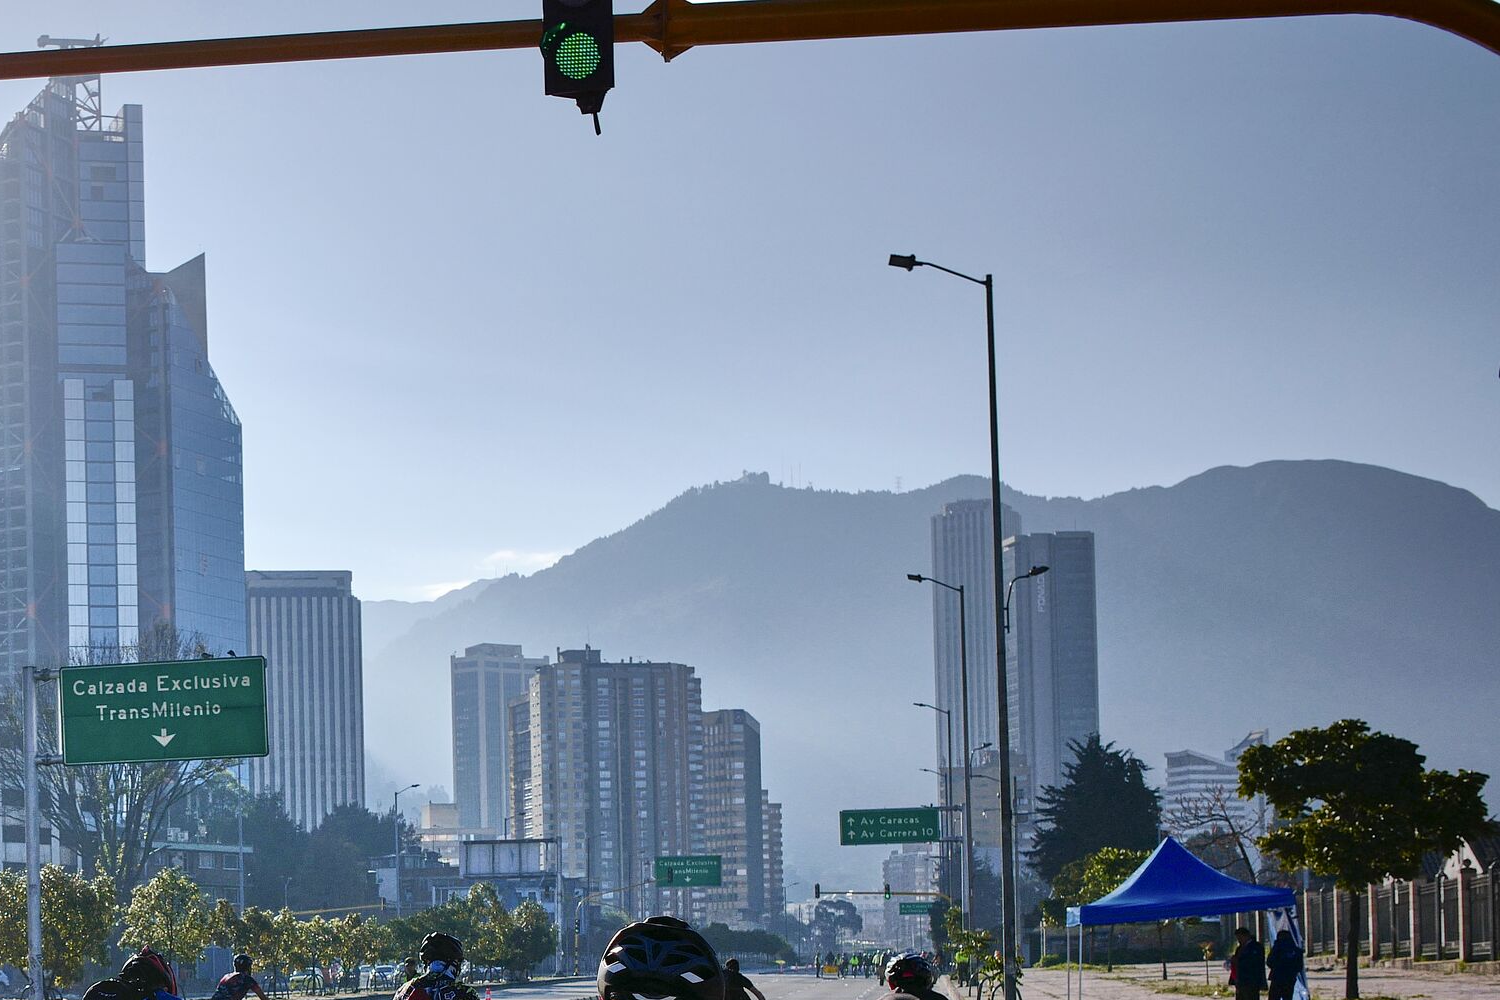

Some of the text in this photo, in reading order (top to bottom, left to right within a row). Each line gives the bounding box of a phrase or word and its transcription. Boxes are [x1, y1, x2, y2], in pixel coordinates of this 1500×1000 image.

[73, 673, 251, 696] Calzada Exclusiva
[96, 701, 221, 721] TransMilenio
[861, 816, 920, 826] Av Caracas
[861, 827, 934, 839] Av Carrera 10
